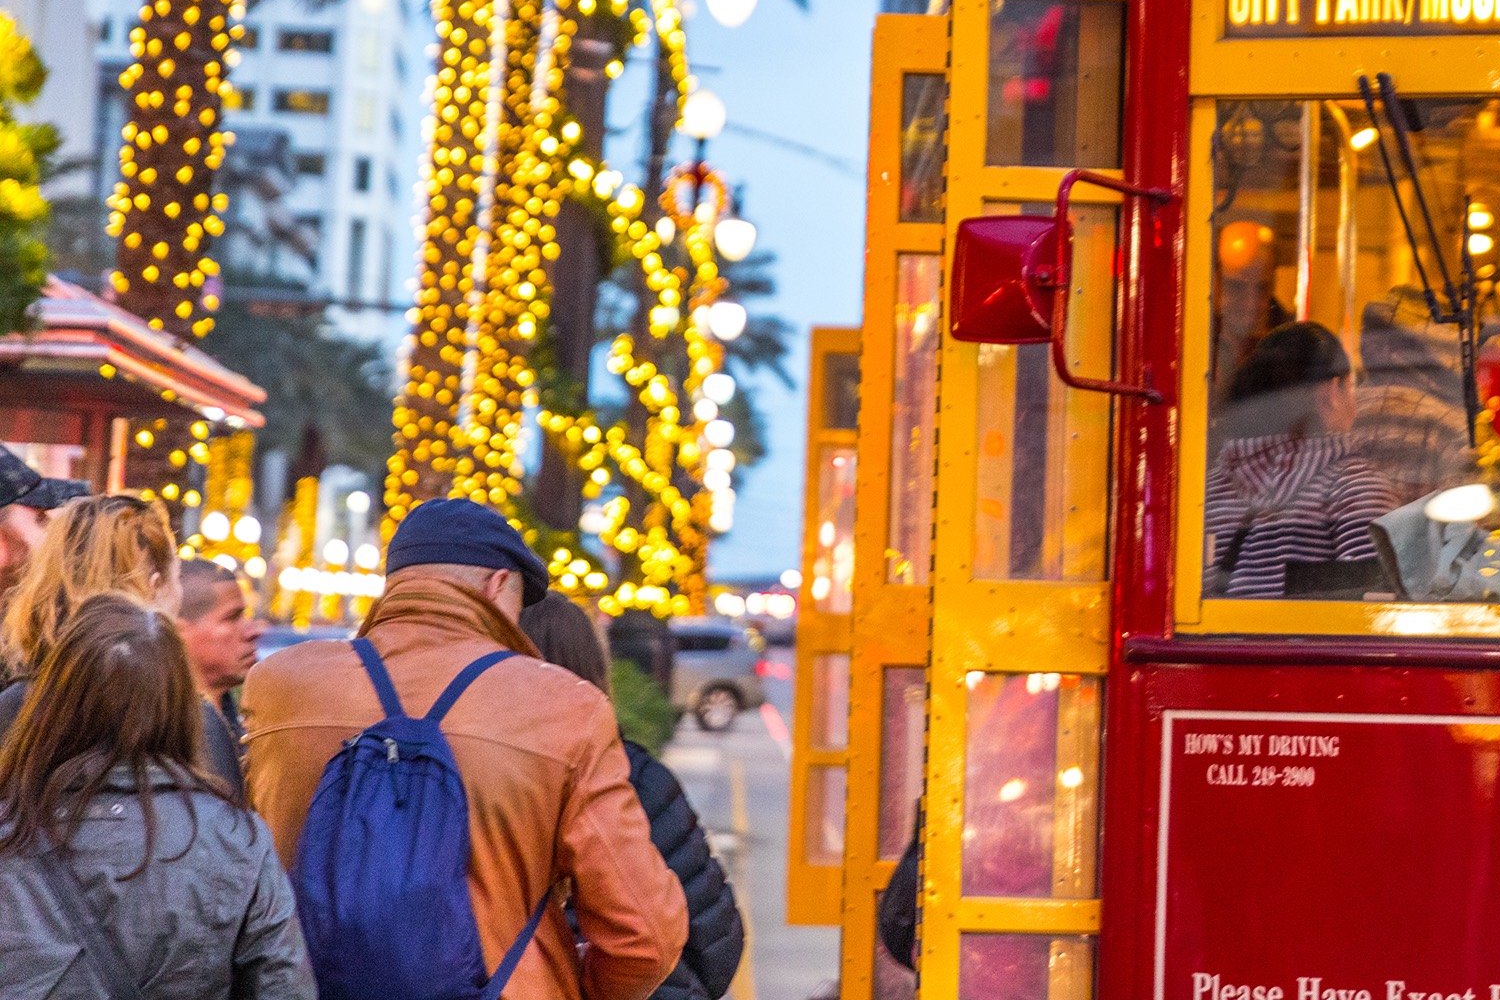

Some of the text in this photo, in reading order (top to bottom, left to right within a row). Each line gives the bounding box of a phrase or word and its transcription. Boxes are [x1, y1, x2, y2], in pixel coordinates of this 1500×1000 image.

[1184, 733, 1340, 758] HOW'S MY DRIVING
[1206, 763, 1248, 786] CALL
[1191, 972, 1284, 1000] Please
